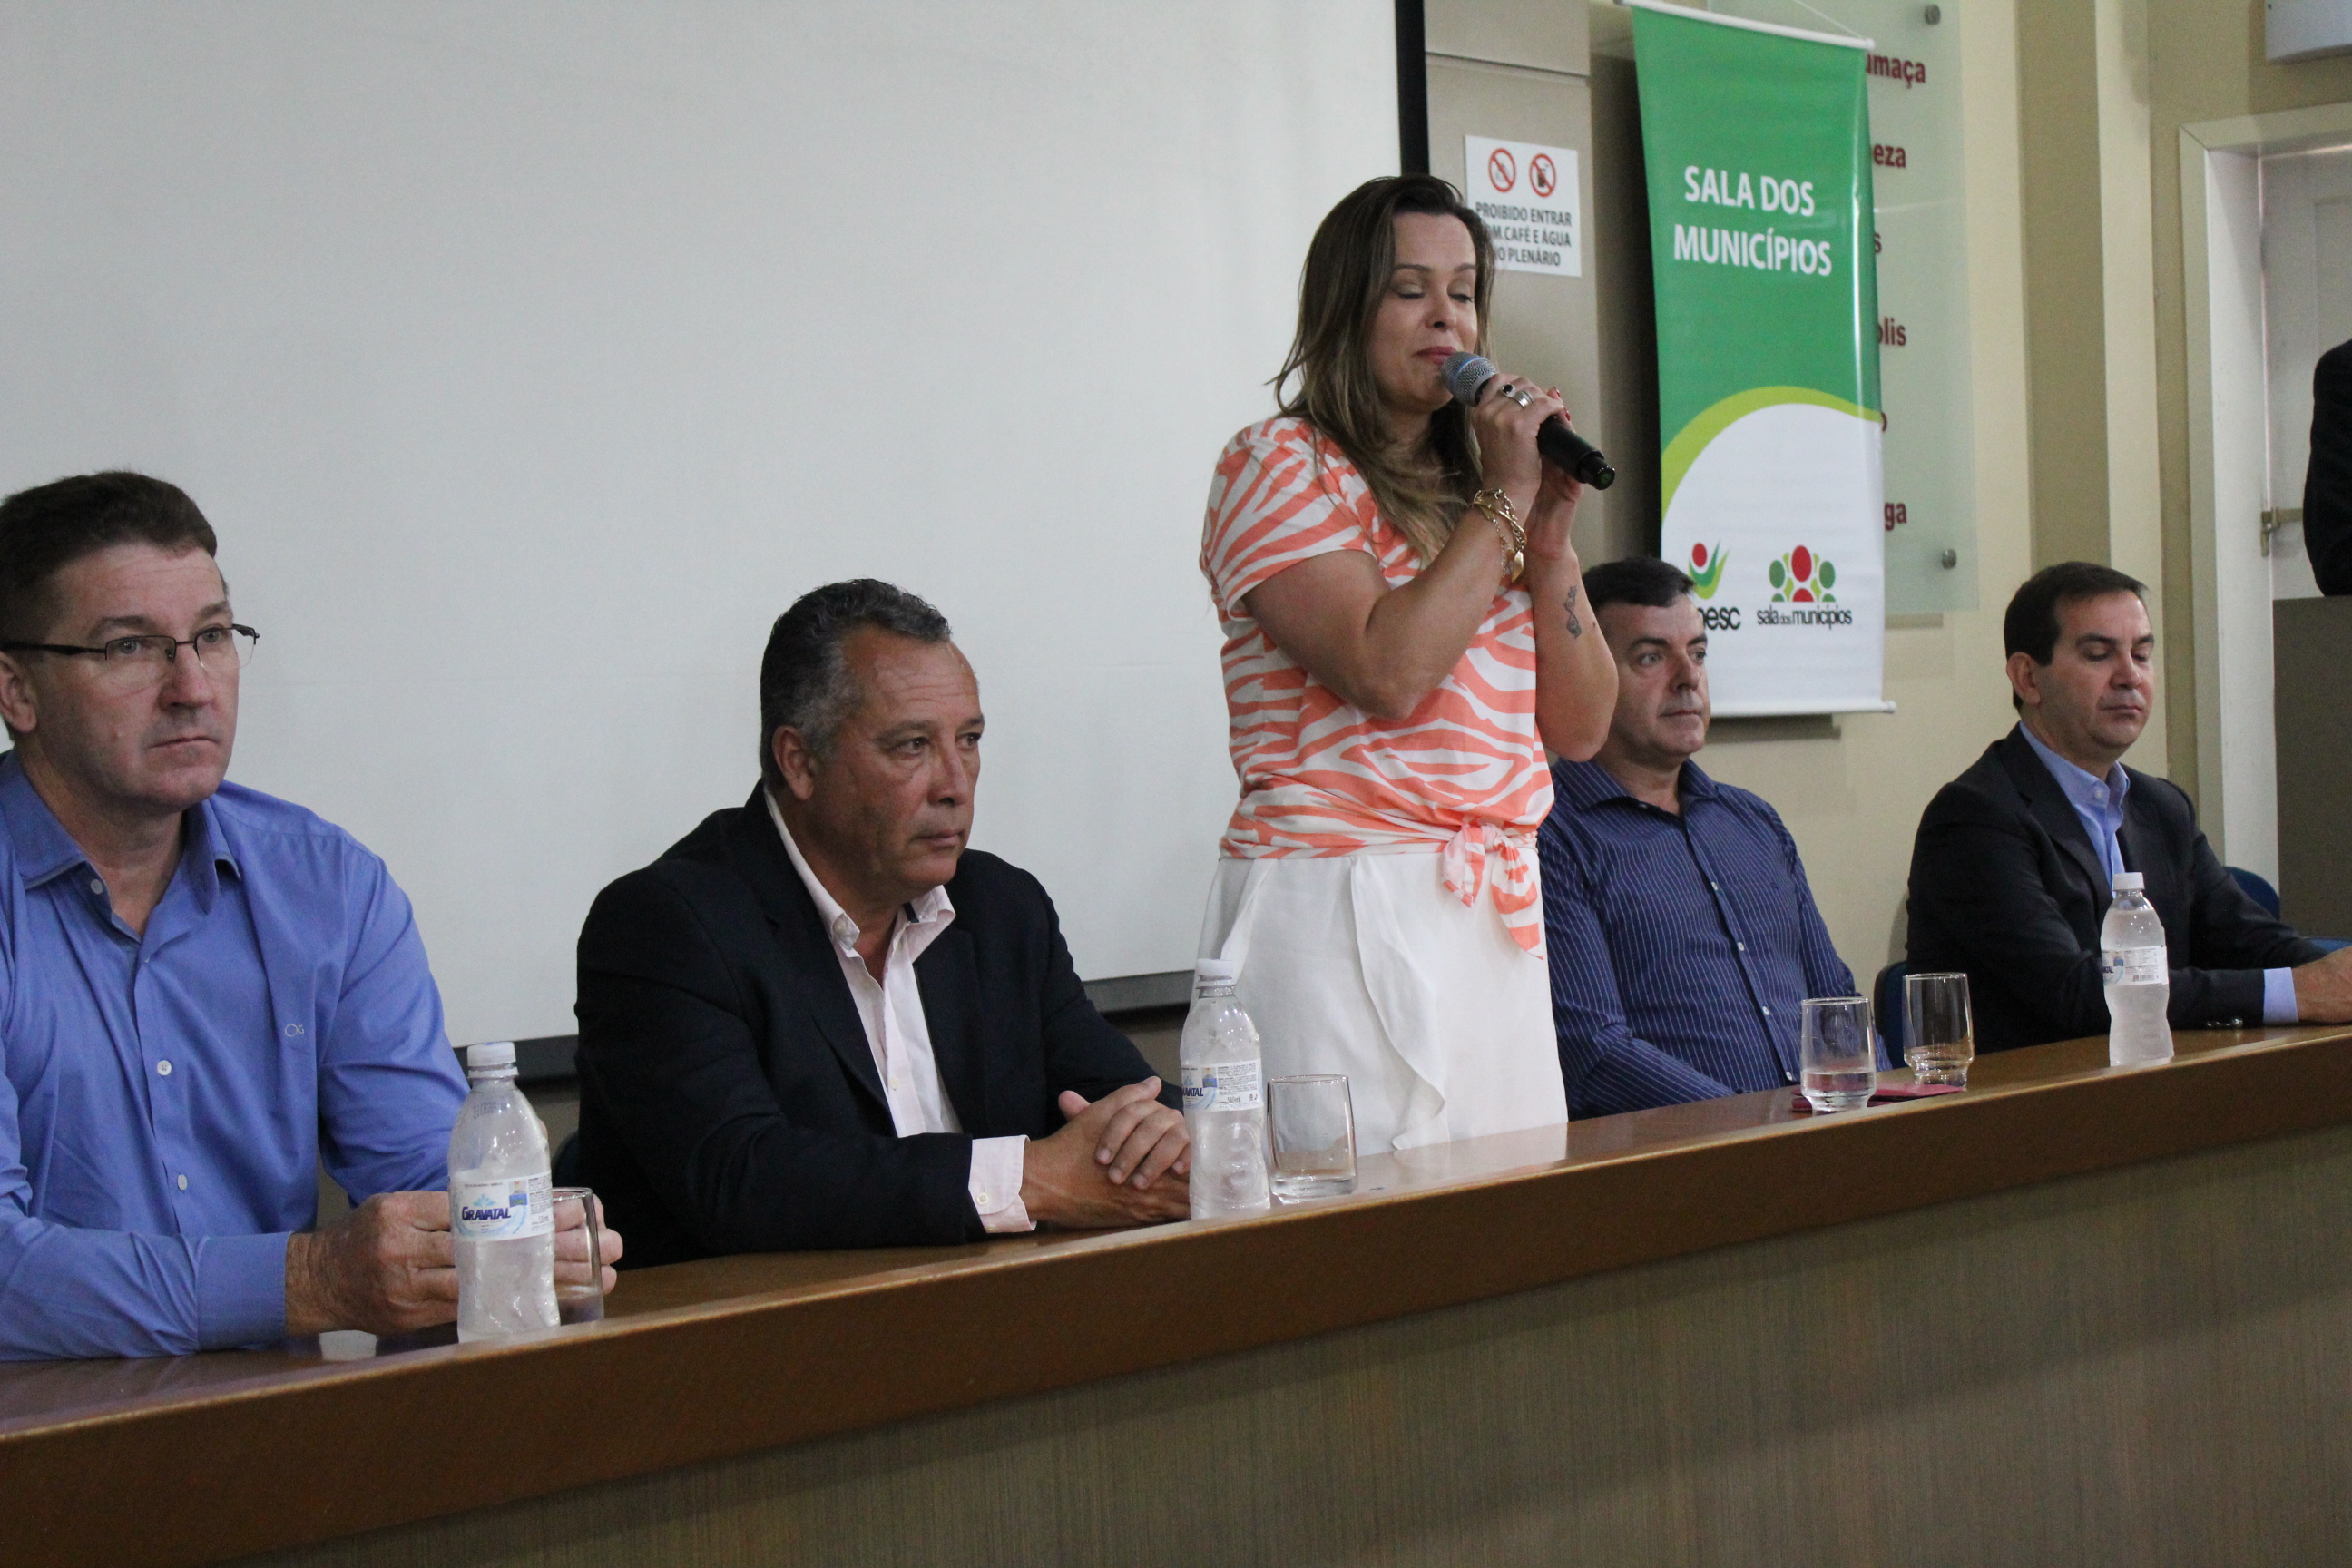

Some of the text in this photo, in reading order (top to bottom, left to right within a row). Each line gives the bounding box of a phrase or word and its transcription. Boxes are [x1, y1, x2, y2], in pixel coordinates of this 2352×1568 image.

[1684, 165, 1815, 217] SALA DOS
[1475, 201, 1572, 227] PROIBIDO ENTRAR
[1504, 225, 1530, 242] CAFÉ
[1533, 229, 1540, 244] E
[1542, 230, 1572, 247] ÁGUA
[1508, 247, 1561, 267] PLENÁRIO
[1674, 223, 1832, 276] MUNICÍPIOS
[1757, 604, 1853, 630] sala dos municípios
[462, 1206, 511, 1220] GRAVATAL
